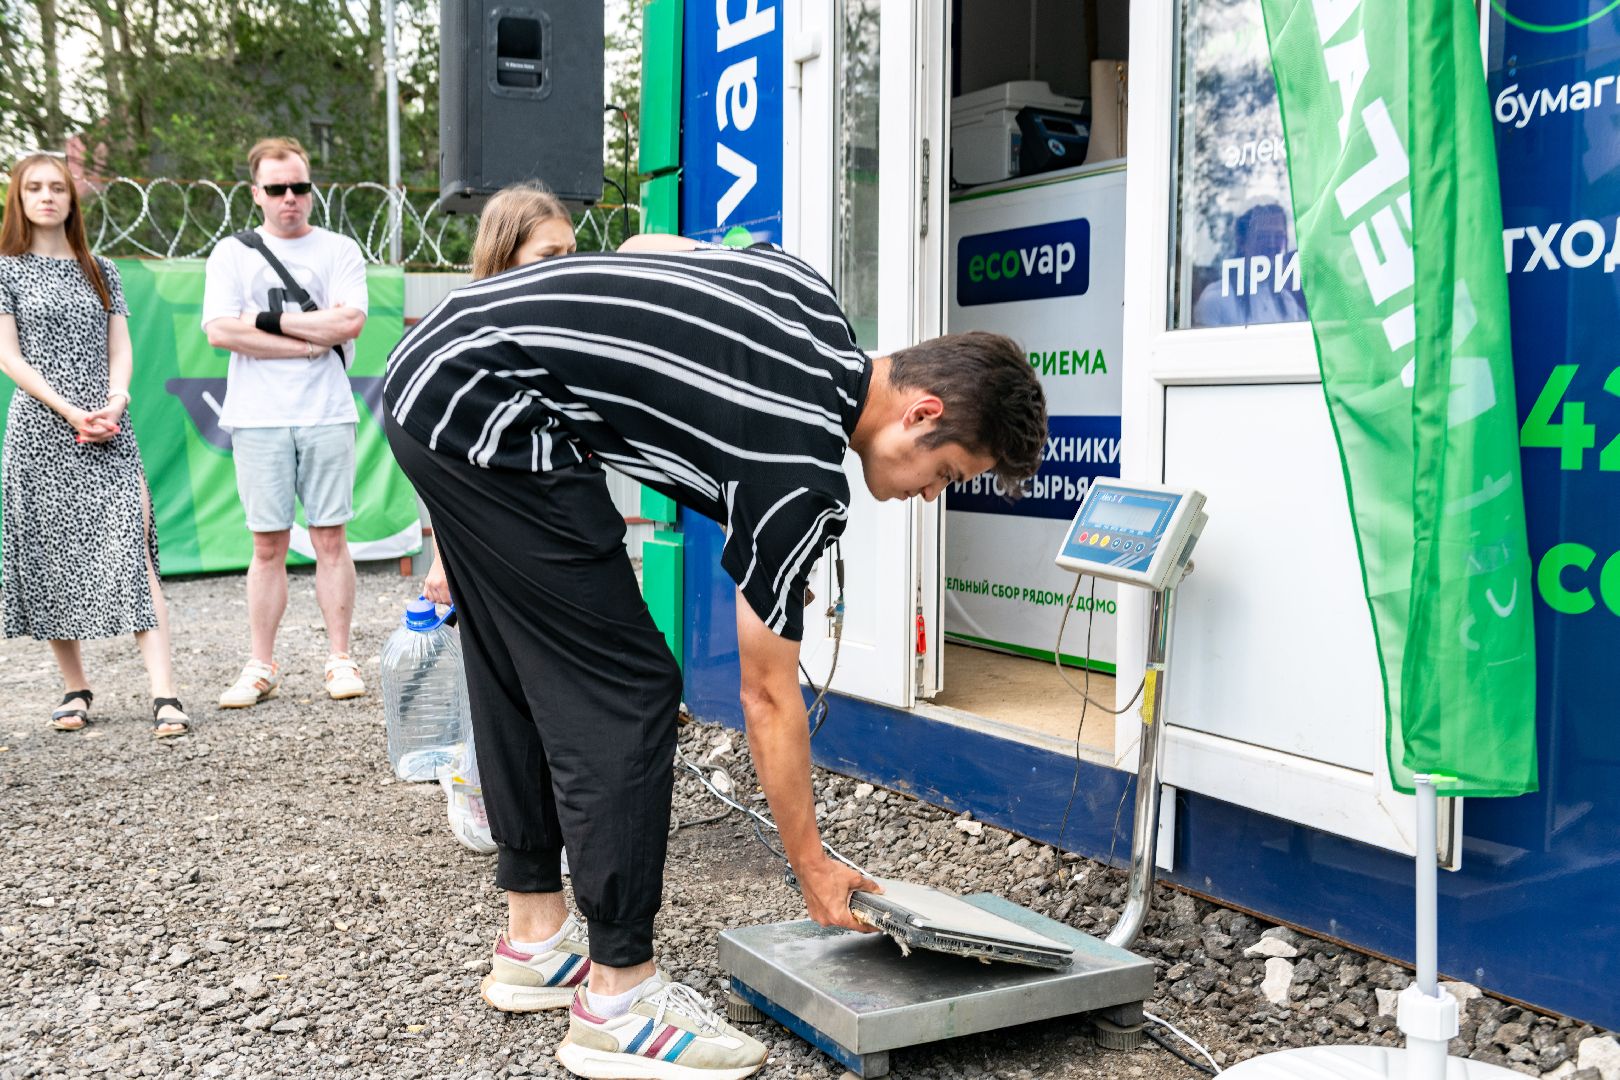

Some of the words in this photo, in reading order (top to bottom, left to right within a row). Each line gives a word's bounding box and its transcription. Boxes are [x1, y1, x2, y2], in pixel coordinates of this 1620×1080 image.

[716, 0, 776, 248] vap
[968, 241, 1076, 285] ecovap
[1222, 251, 1301, 298] ПРИ
[1026, 349, 1107, 376] РИЕМА
[1041, 436, 1122, 464] ХНИКИ
[971, 472, 1088, 502] ВТОСЫРЬЯ
[945, 577, 989, 596] ЕЛЬНЫЙ
[991, 583, 1020, 600] СБОР
[1022, 588, 1064, 608] РЯДОМ
